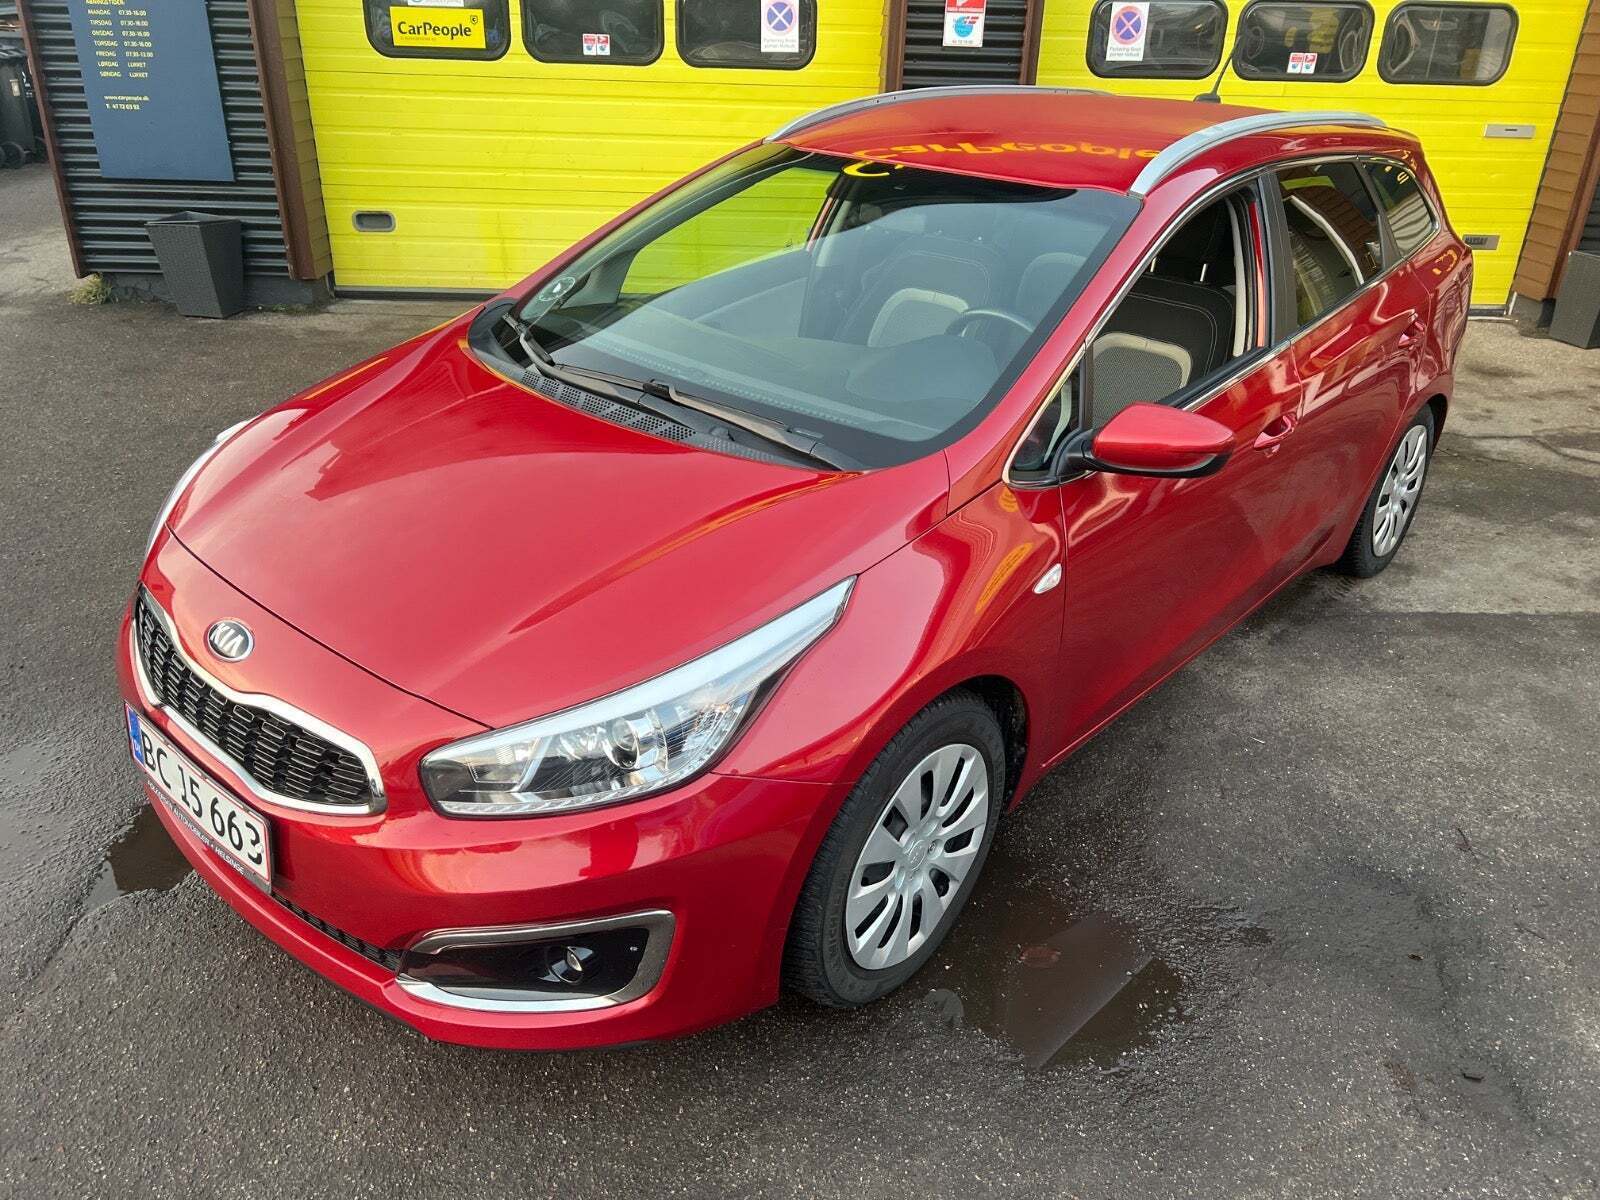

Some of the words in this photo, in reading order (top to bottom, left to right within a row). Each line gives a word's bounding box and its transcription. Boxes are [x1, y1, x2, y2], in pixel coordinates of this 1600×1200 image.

[397, 21, 472, 40] CarPeople
[210, 622, 245, 657] KIA
[141, 729, 172, 790] BC
[177, 764, 203, 818] 15
[210, 797, 263, 865] 663
